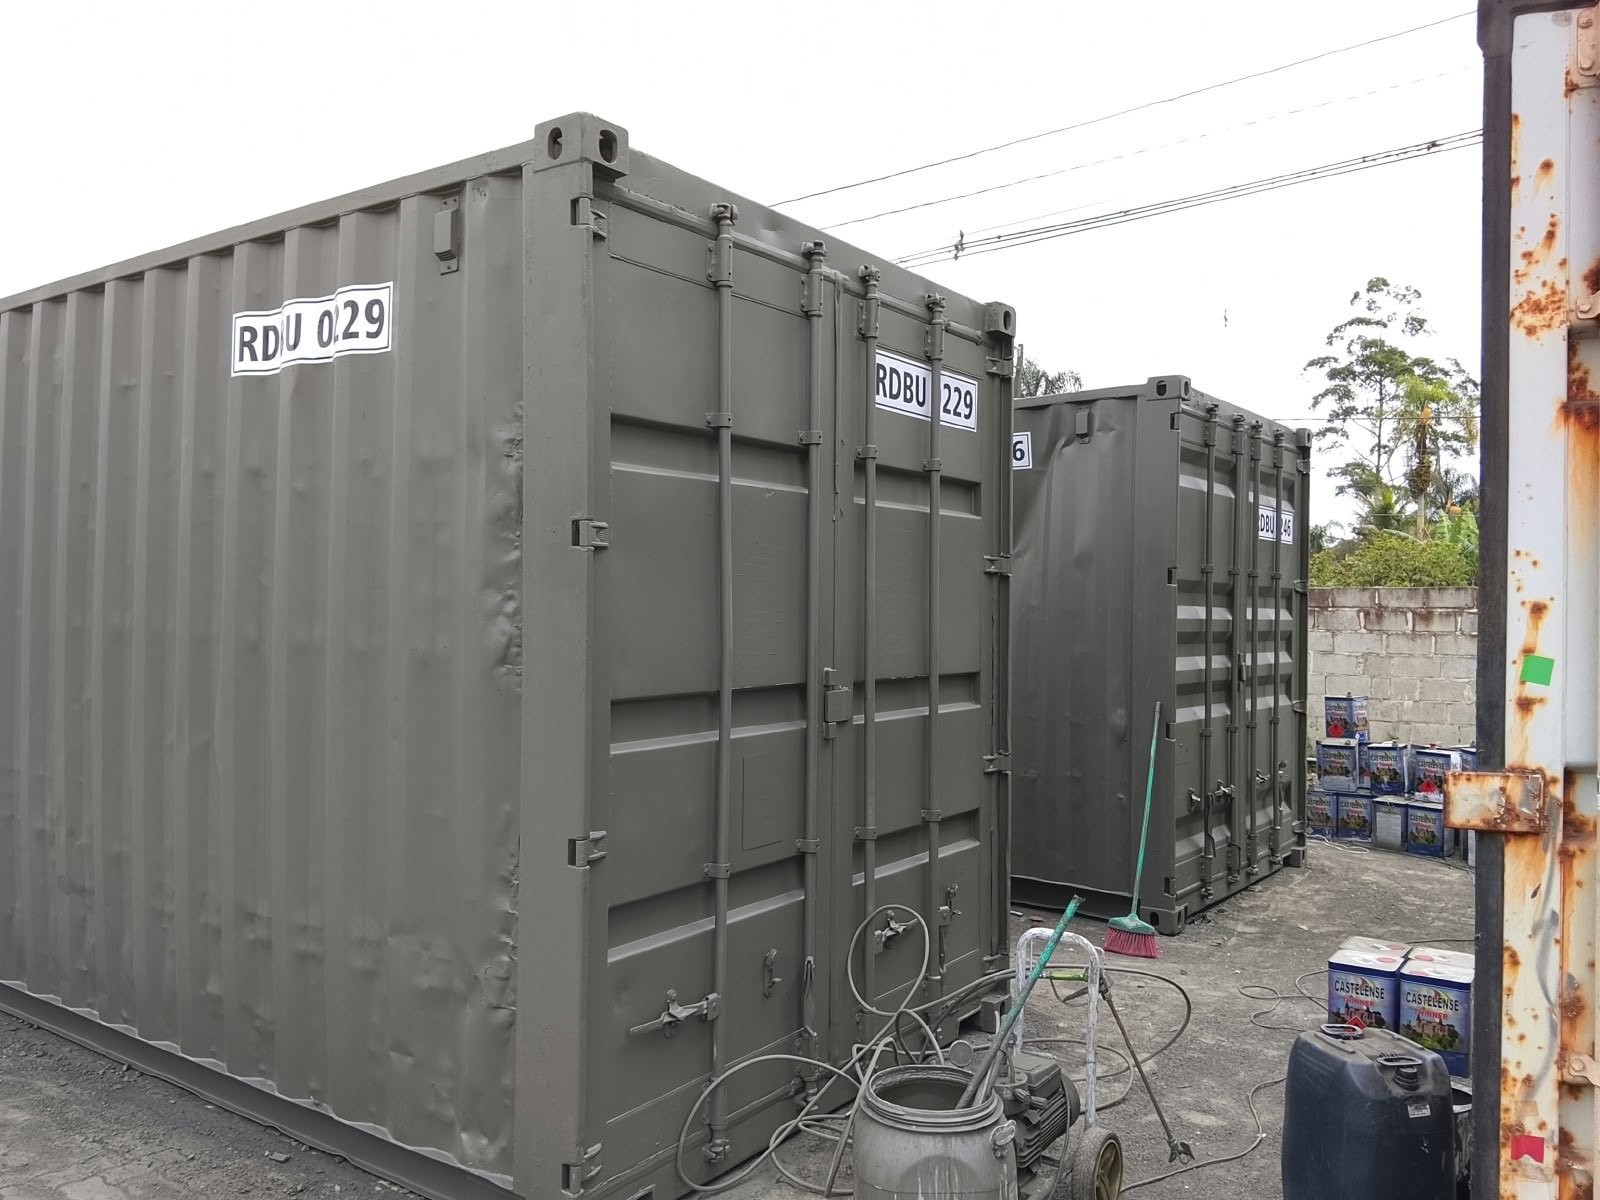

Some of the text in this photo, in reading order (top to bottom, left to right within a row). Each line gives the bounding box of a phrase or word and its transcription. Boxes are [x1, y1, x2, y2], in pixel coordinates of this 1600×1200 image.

[238, 312, 302, 362] RDU
[876, 362, 926, 408] RDBU
[1260, 513, 1291, 537] DBU 46
[1334, 980, 1385, 1000] CASTELENSE
[1405, 991, 1459, 1012] CASTELENSE
